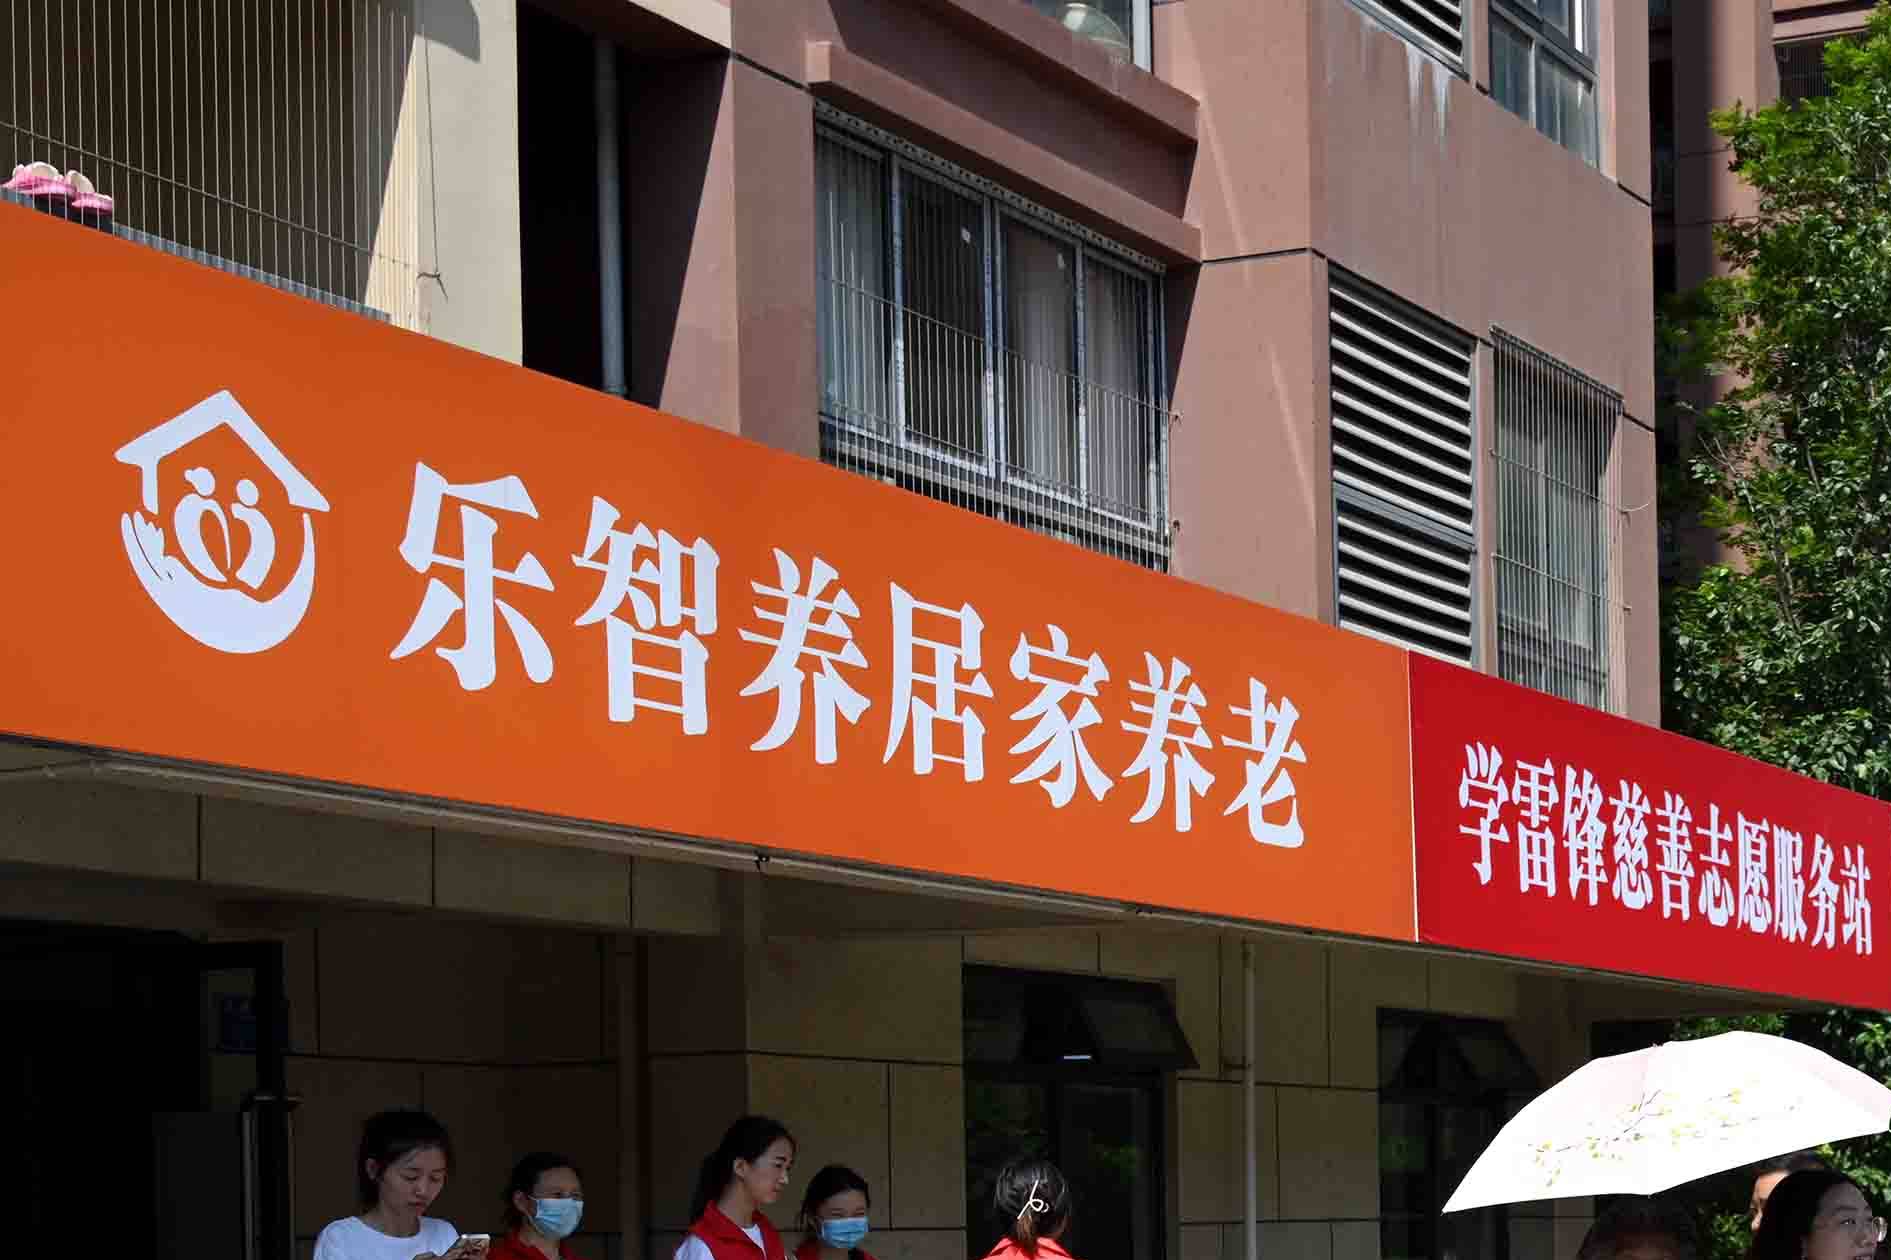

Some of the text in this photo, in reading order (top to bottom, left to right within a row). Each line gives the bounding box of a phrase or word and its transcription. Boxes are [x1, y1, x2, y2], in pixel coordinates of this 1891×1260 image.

[390, 462, 1307, 848] 乐智养居家养老
[1458, 742, 1874, 955] 学雷锋慈善志愿服务站
